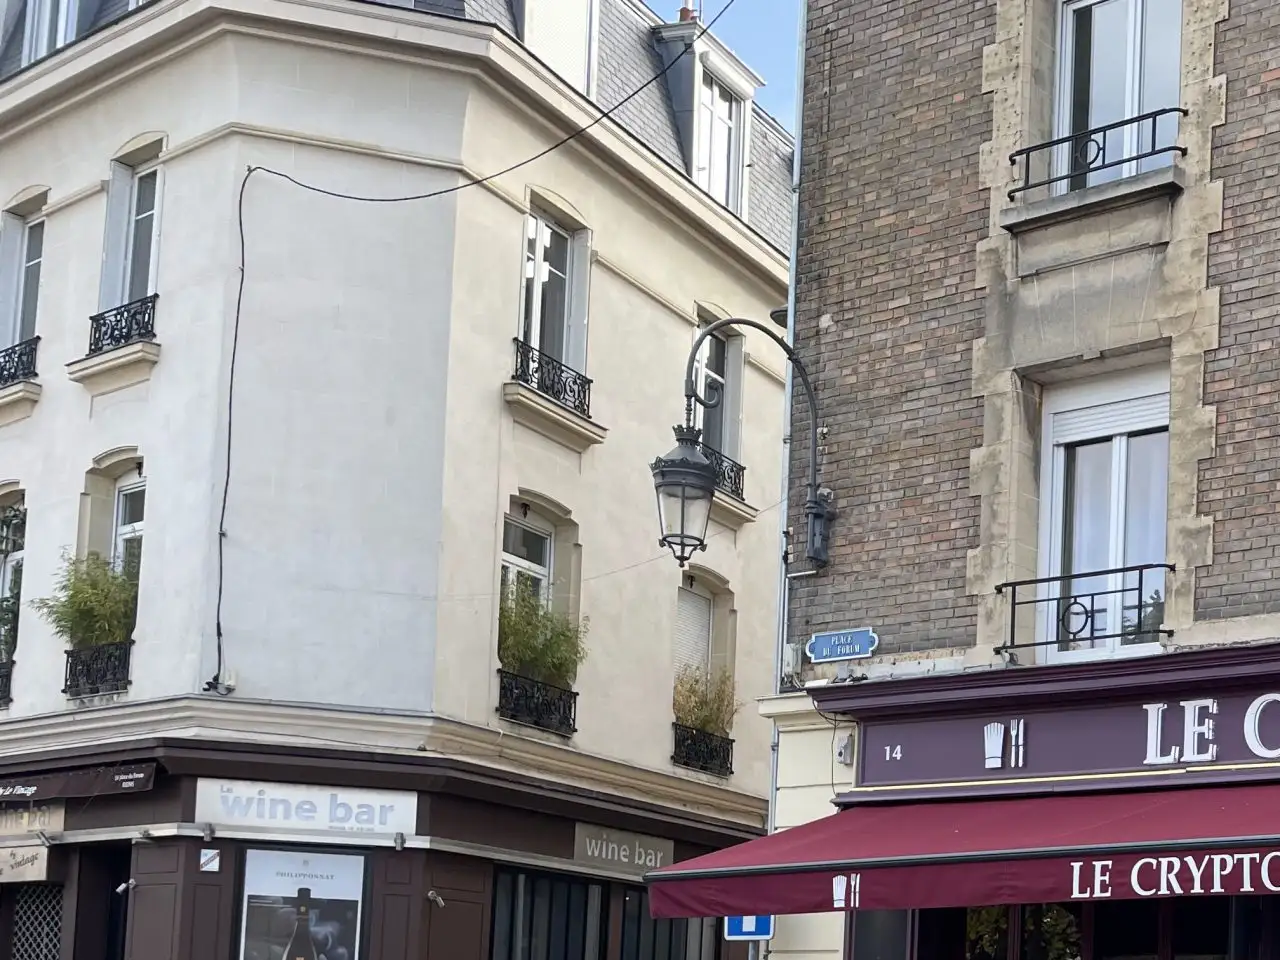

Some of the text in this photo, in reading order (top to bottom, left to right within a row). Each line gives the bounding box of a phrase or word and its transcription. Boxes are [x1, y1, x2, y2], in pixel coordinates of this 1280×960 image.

[823, 644, 860, 657] DU FORUM
[831, 635, 852, 645] PLACE
[1142, 698, 1219, 765] LE
[884, 744, 902, 761] 14
[220, 789, 395, 826] wine bar
[585, 833, 664, 868] wine bar
[1070, 860, 1113, 898] LE
